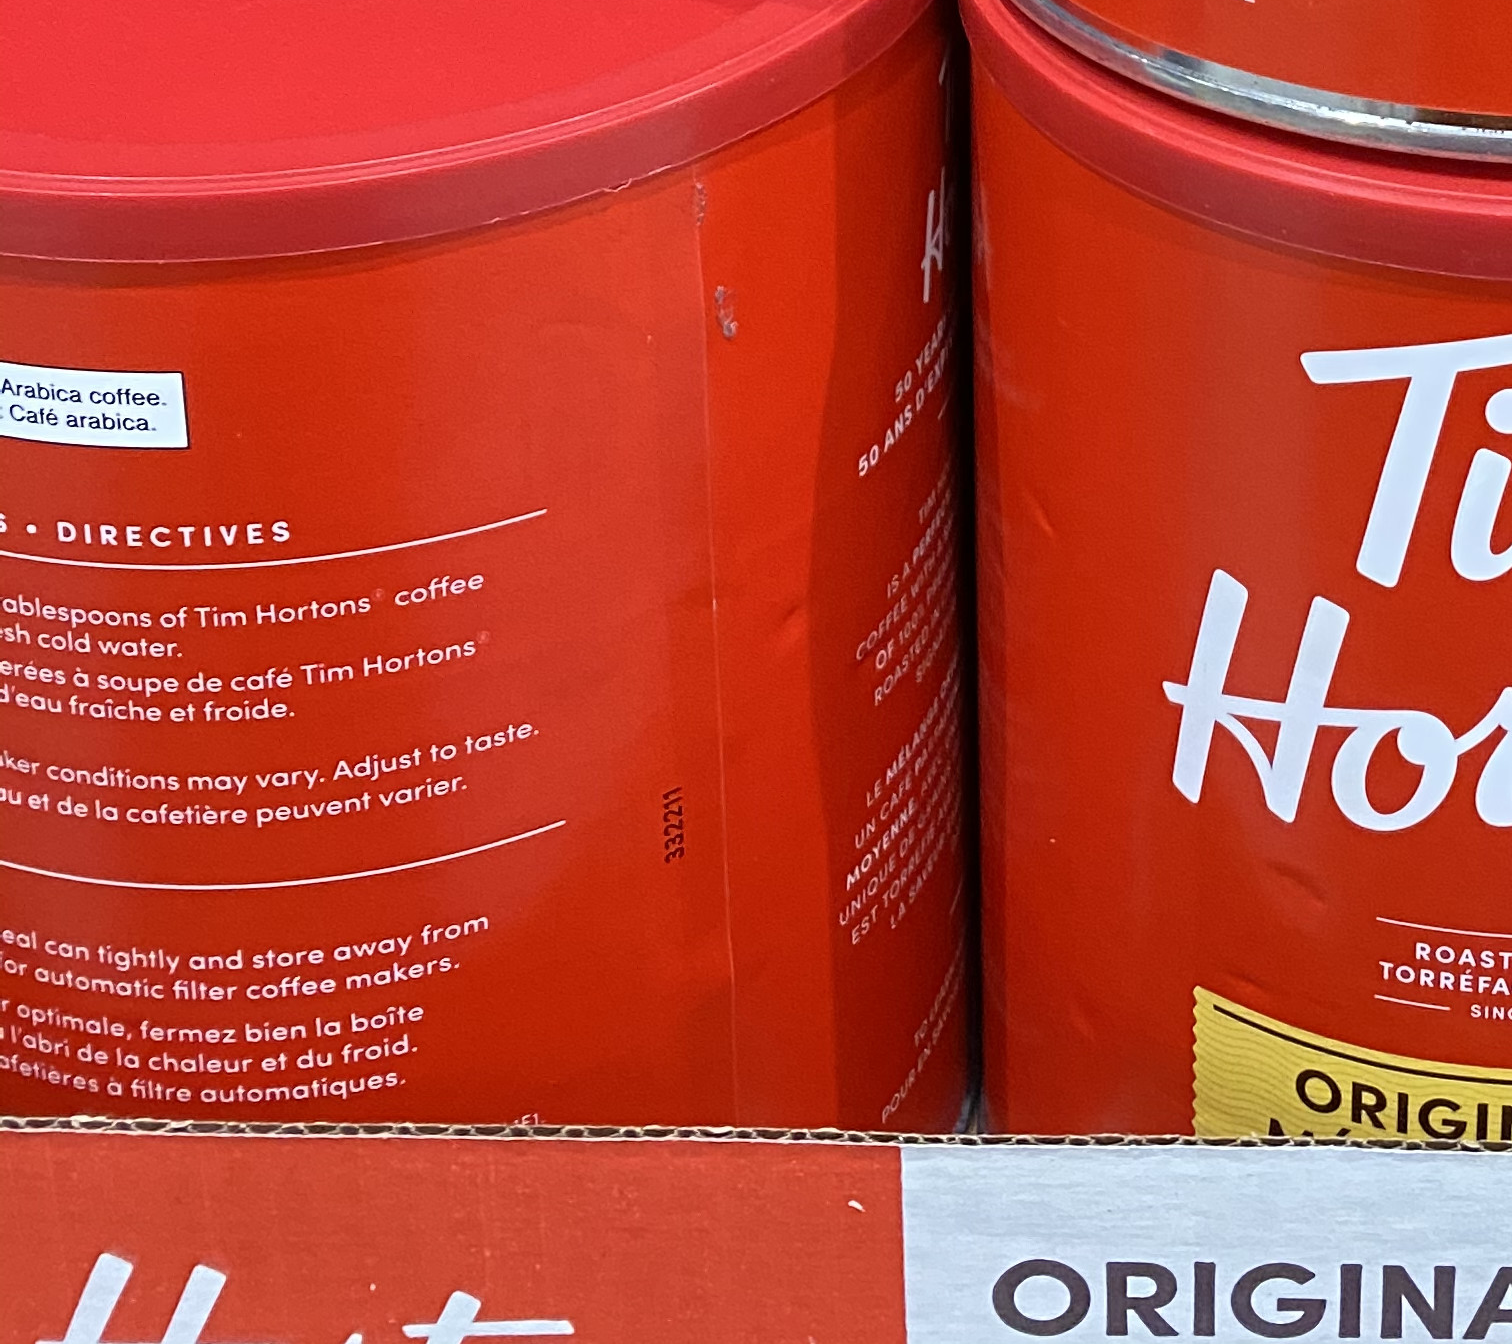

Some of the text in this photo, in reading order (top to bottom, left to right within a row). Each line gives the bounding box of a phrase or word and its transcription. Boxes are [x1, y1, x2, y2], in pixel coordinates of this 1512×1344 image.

[1, 377, 168, 406] Arabica coffee.
[9, 404, 157, 432] Café arabica.
[858, 404, 913, 477] 50 ANS
[57, 520, 291, 548] DIRECTIVES
[159, 606, 188, 629] of
[193, 606, 247, 628] Tim
[394, 574, 485, 607] coffee
[37, 631, 183, 658] cold water.
[856, 594, 908, 661] COFFEE
[72, 667, 90, 688] à
[96, 676, 180, 697] soupe
[186, 672, 223, 694] de
[230, 667, 293, 692] café
[300, 663, 354, 686] Tim
[68, 694, 162, 723] fraîche
[169, 705, 196, 723] et
[203, 698, 296, 723] froide.
[46, 723, 540, 795] conditions may vary. Adjust to taste.
[27, 776, 468, 828] et de la cafetière peuvent varier.
[846, 796, 917, 891] MOYENNE
[839, 853, 896, 927] UNIQUE
[44, 940, 90, 962] can
[98, 945, 180, 975] tightly
[188, 949, 244, 970] and
[252, 949, 325, 969] store
[333, 934, 413, 961] away
[421, 916, 489, 946] from
[34, 955, 461, 1001] automatic filter coffee makers.
[16, 1004, 133, 1041] optimale,
[140, 1020, 237, 1043] fermez
[245, 1022, 307, 1043] bien
[315, 1017, 341, 1038] la
[350, 1005, 424, 1033] boîte
[10, 1024, 418, 1073] l'abri de la chaleur et du froid.
[106, 1076, 123, 1097] à
[130, 1077, 192, 1101] filtre
[200, 1071, 406, 1103] automatiques.
